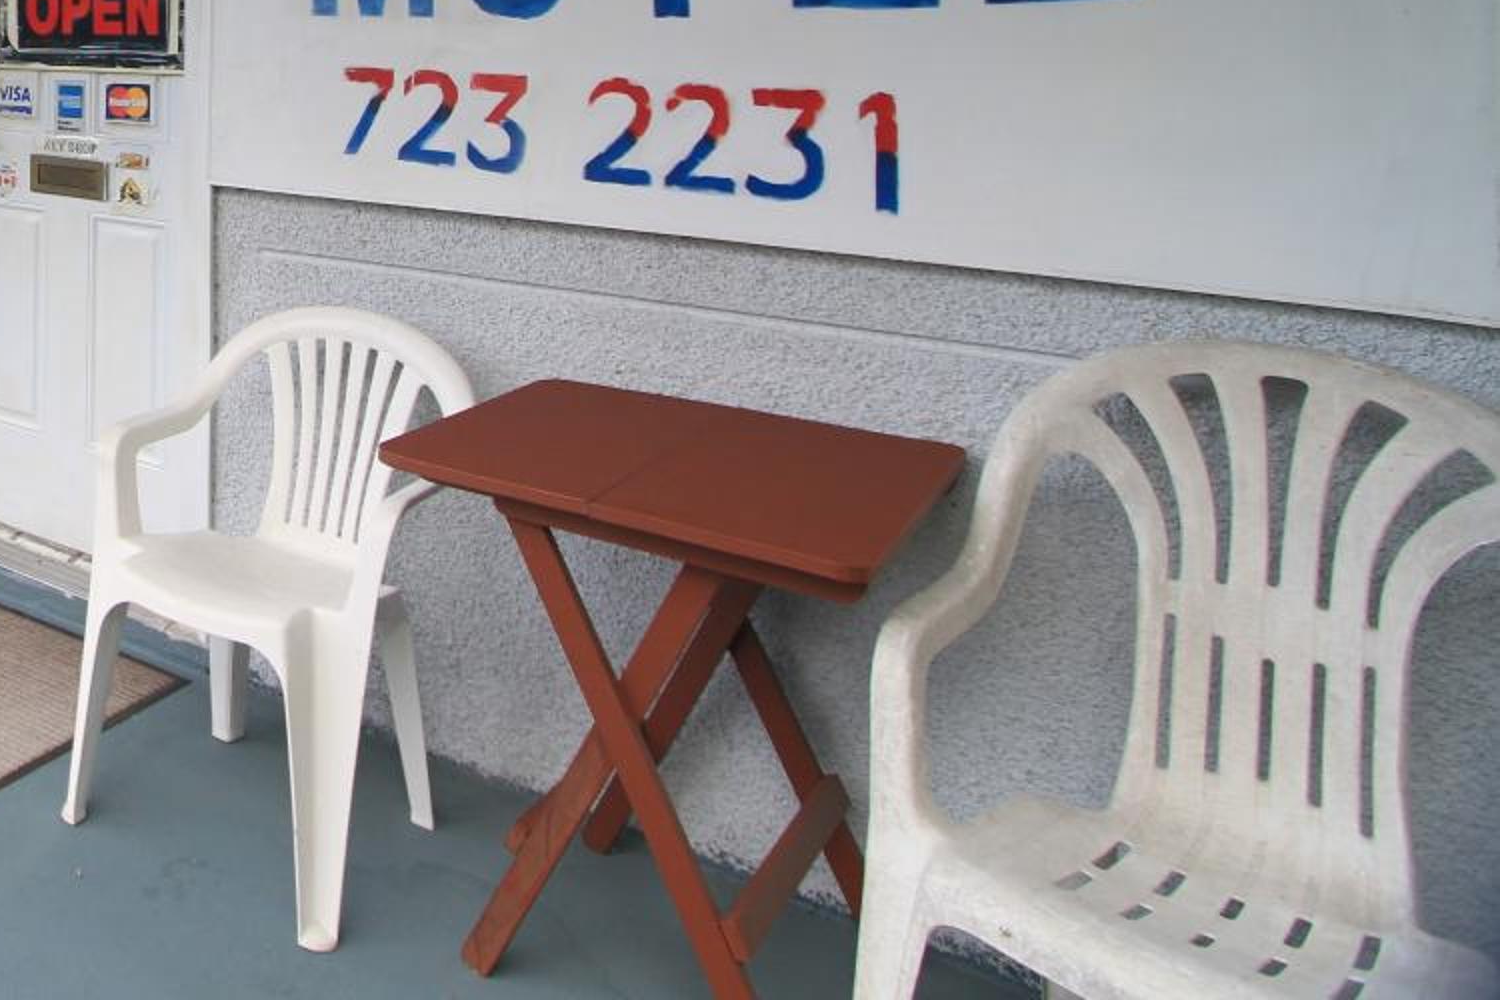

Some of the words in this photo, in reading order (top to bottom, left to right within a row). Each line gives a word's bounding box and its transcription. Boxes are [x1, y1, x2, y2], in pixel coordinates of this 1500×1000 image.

[0, 86, 31, 102] VISA
[344, 68, 528, 174] 723
[584, 77, 900, 216] 2231
